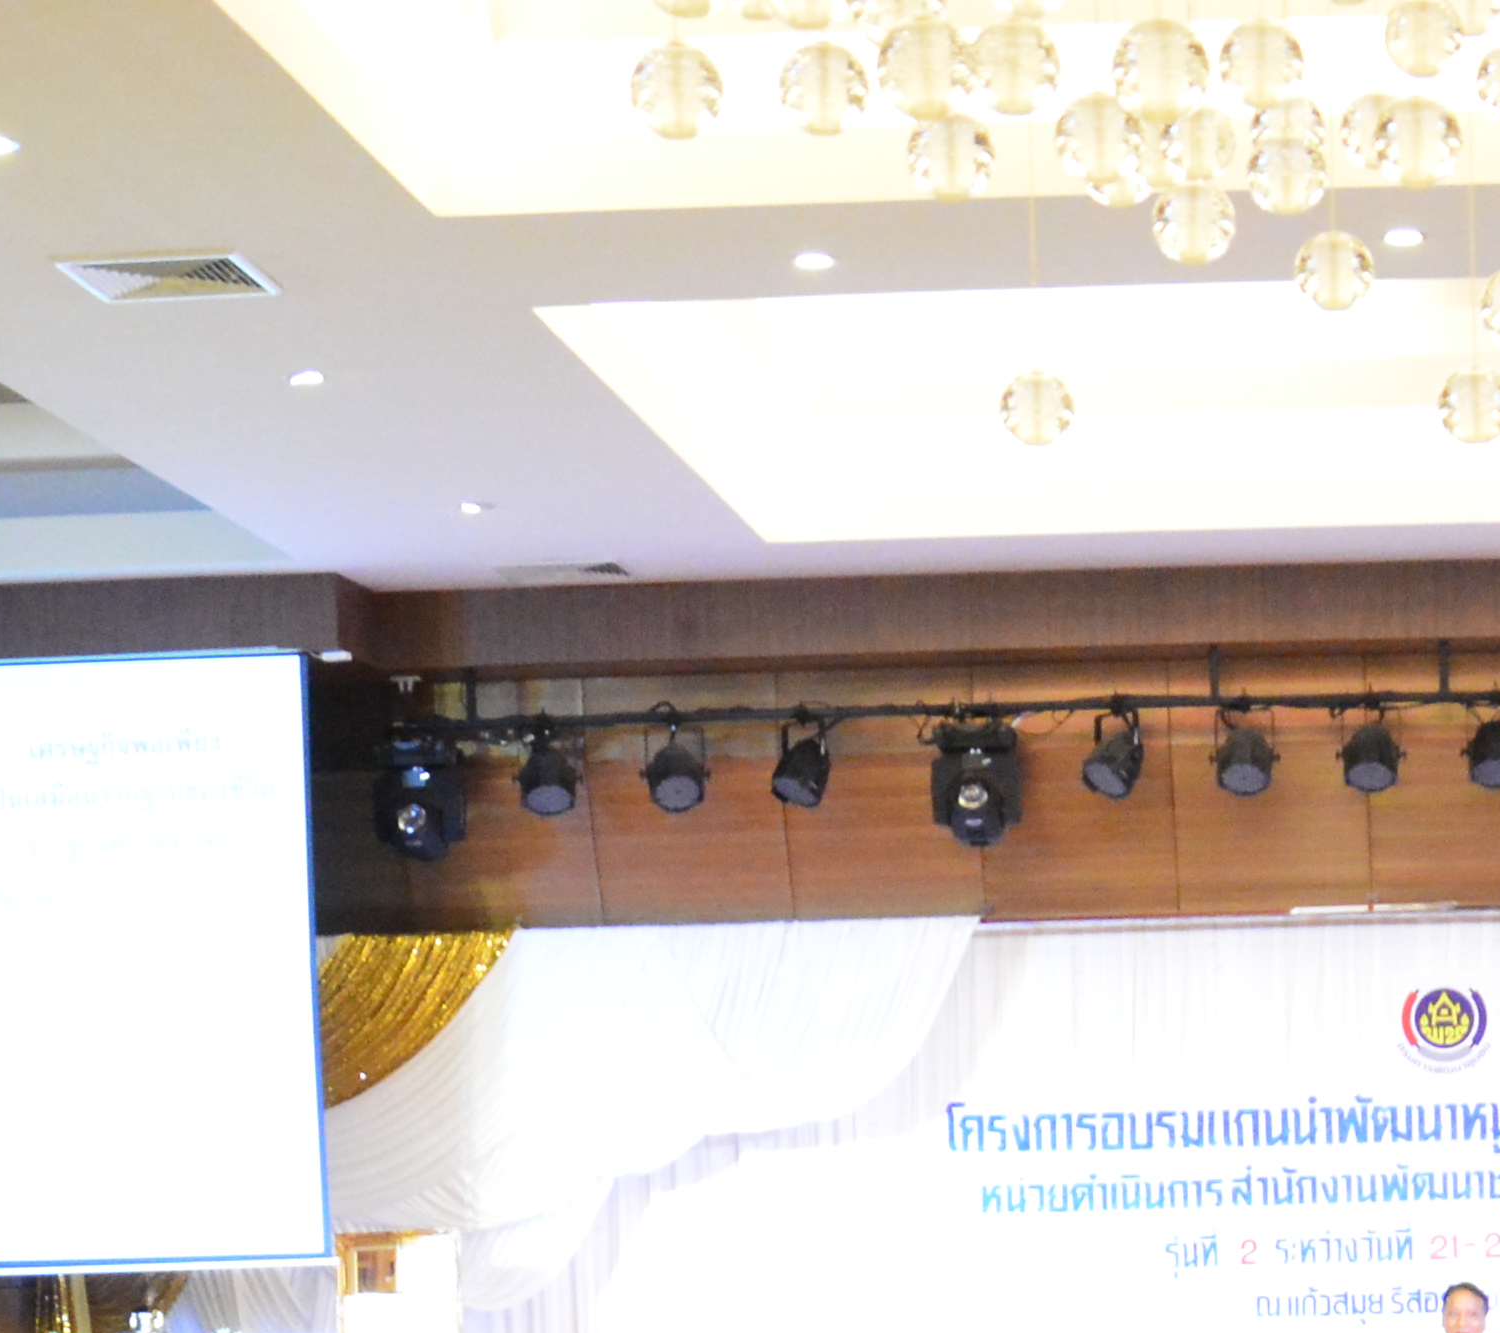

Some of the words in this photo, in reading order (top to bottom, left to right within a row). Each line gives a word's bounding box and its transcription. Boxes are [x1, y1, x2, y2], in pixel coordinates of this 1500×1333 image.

[29, 728, 221, 765] เศรษฐกิจพอเพียง
[1165, 1229, 1218, 1278] รุ่นที่
[1240, 1239, 1258, 1265] 2
[1274, 1222, 1414, 1264] ระหว่างวันที่
